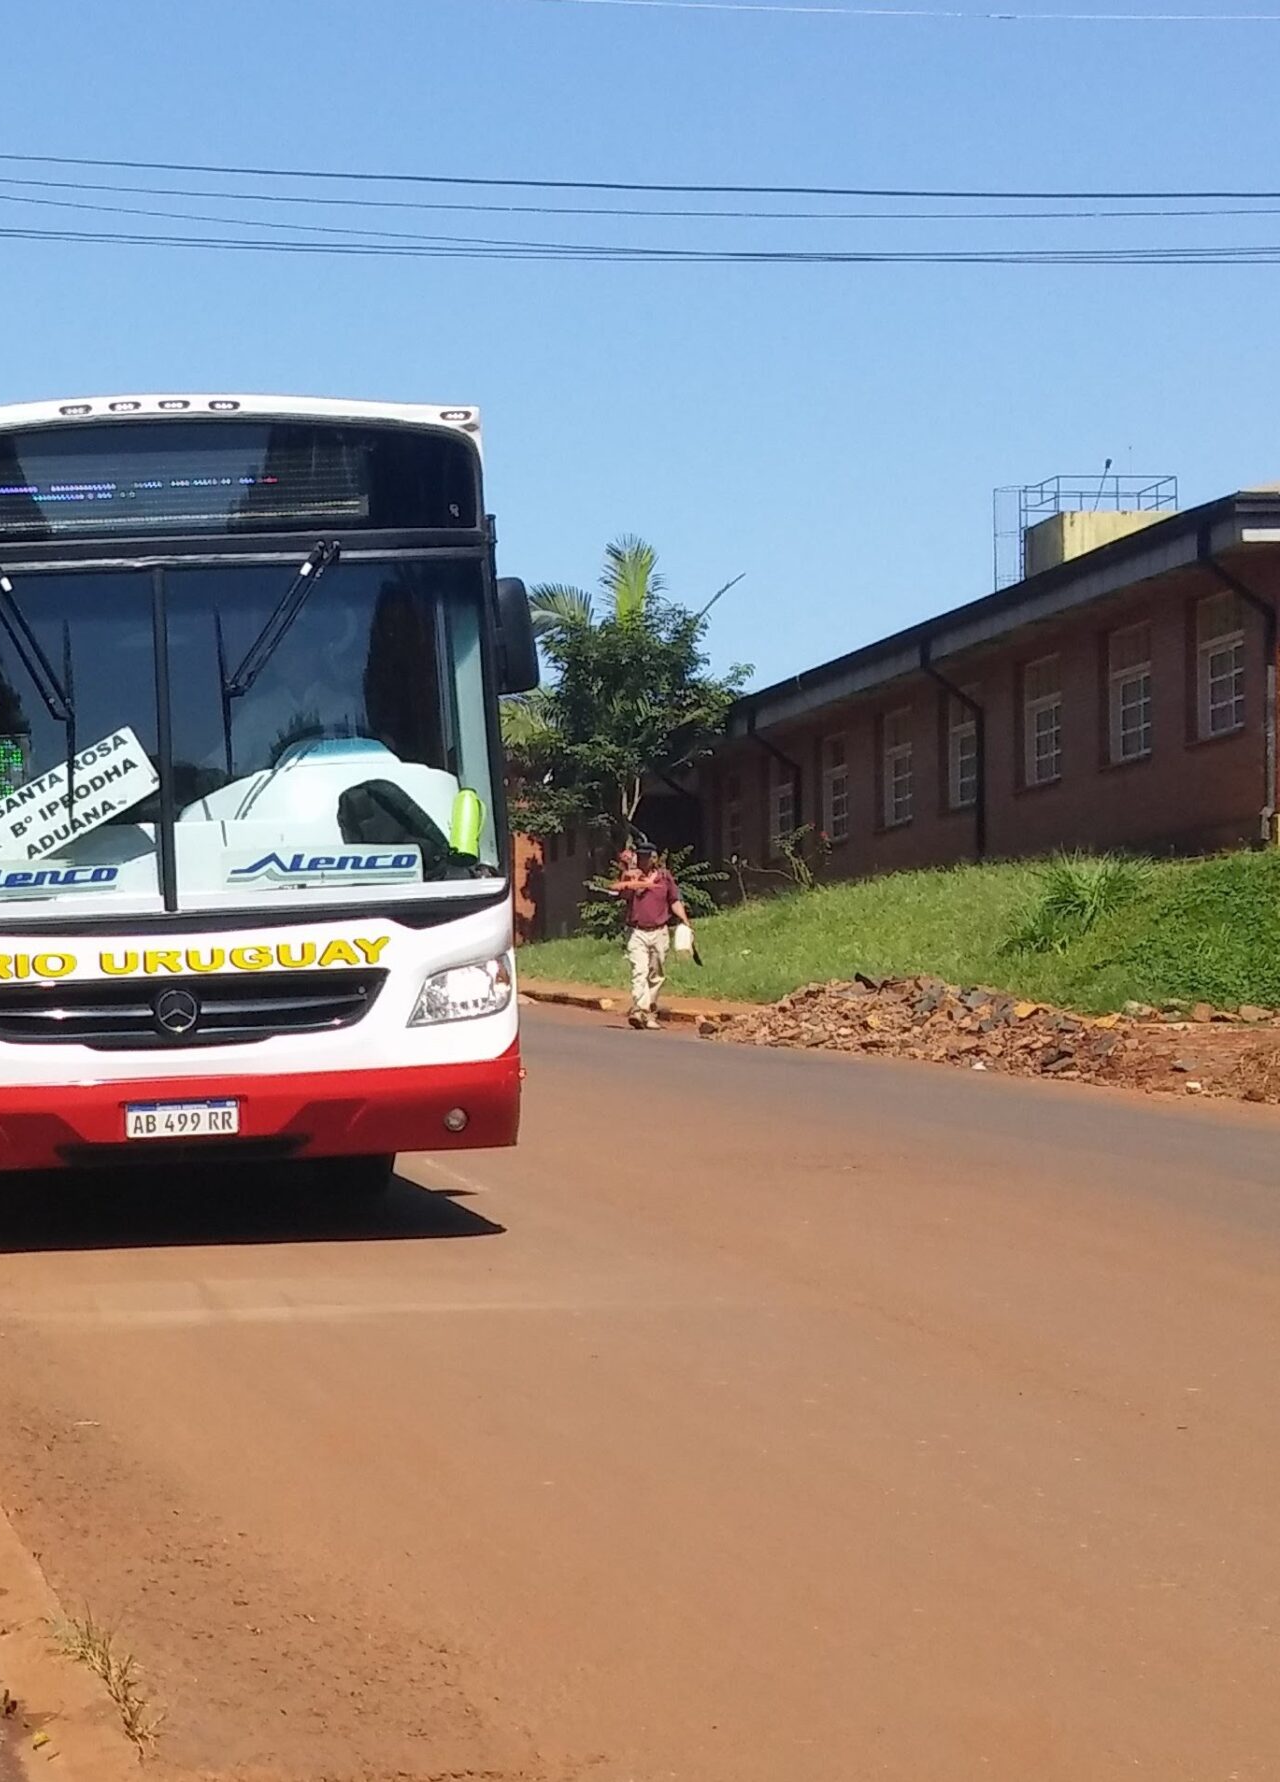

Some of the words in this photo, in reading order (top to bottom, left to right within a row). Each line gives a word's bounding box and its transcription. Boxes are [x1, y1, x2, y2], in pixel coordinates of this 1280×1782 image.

[66, 735, 128, 775] ROSA
[38, 758, 139, 822] IPRODHA
[25, 799, 117, 860] ADUANA
[100, 936, 391, 974] URUGUAY
[133, 1114, 157, 1134] AB
[164, 1112, 201, 1132] 499
[208, 1111, 233, 1131] RR
